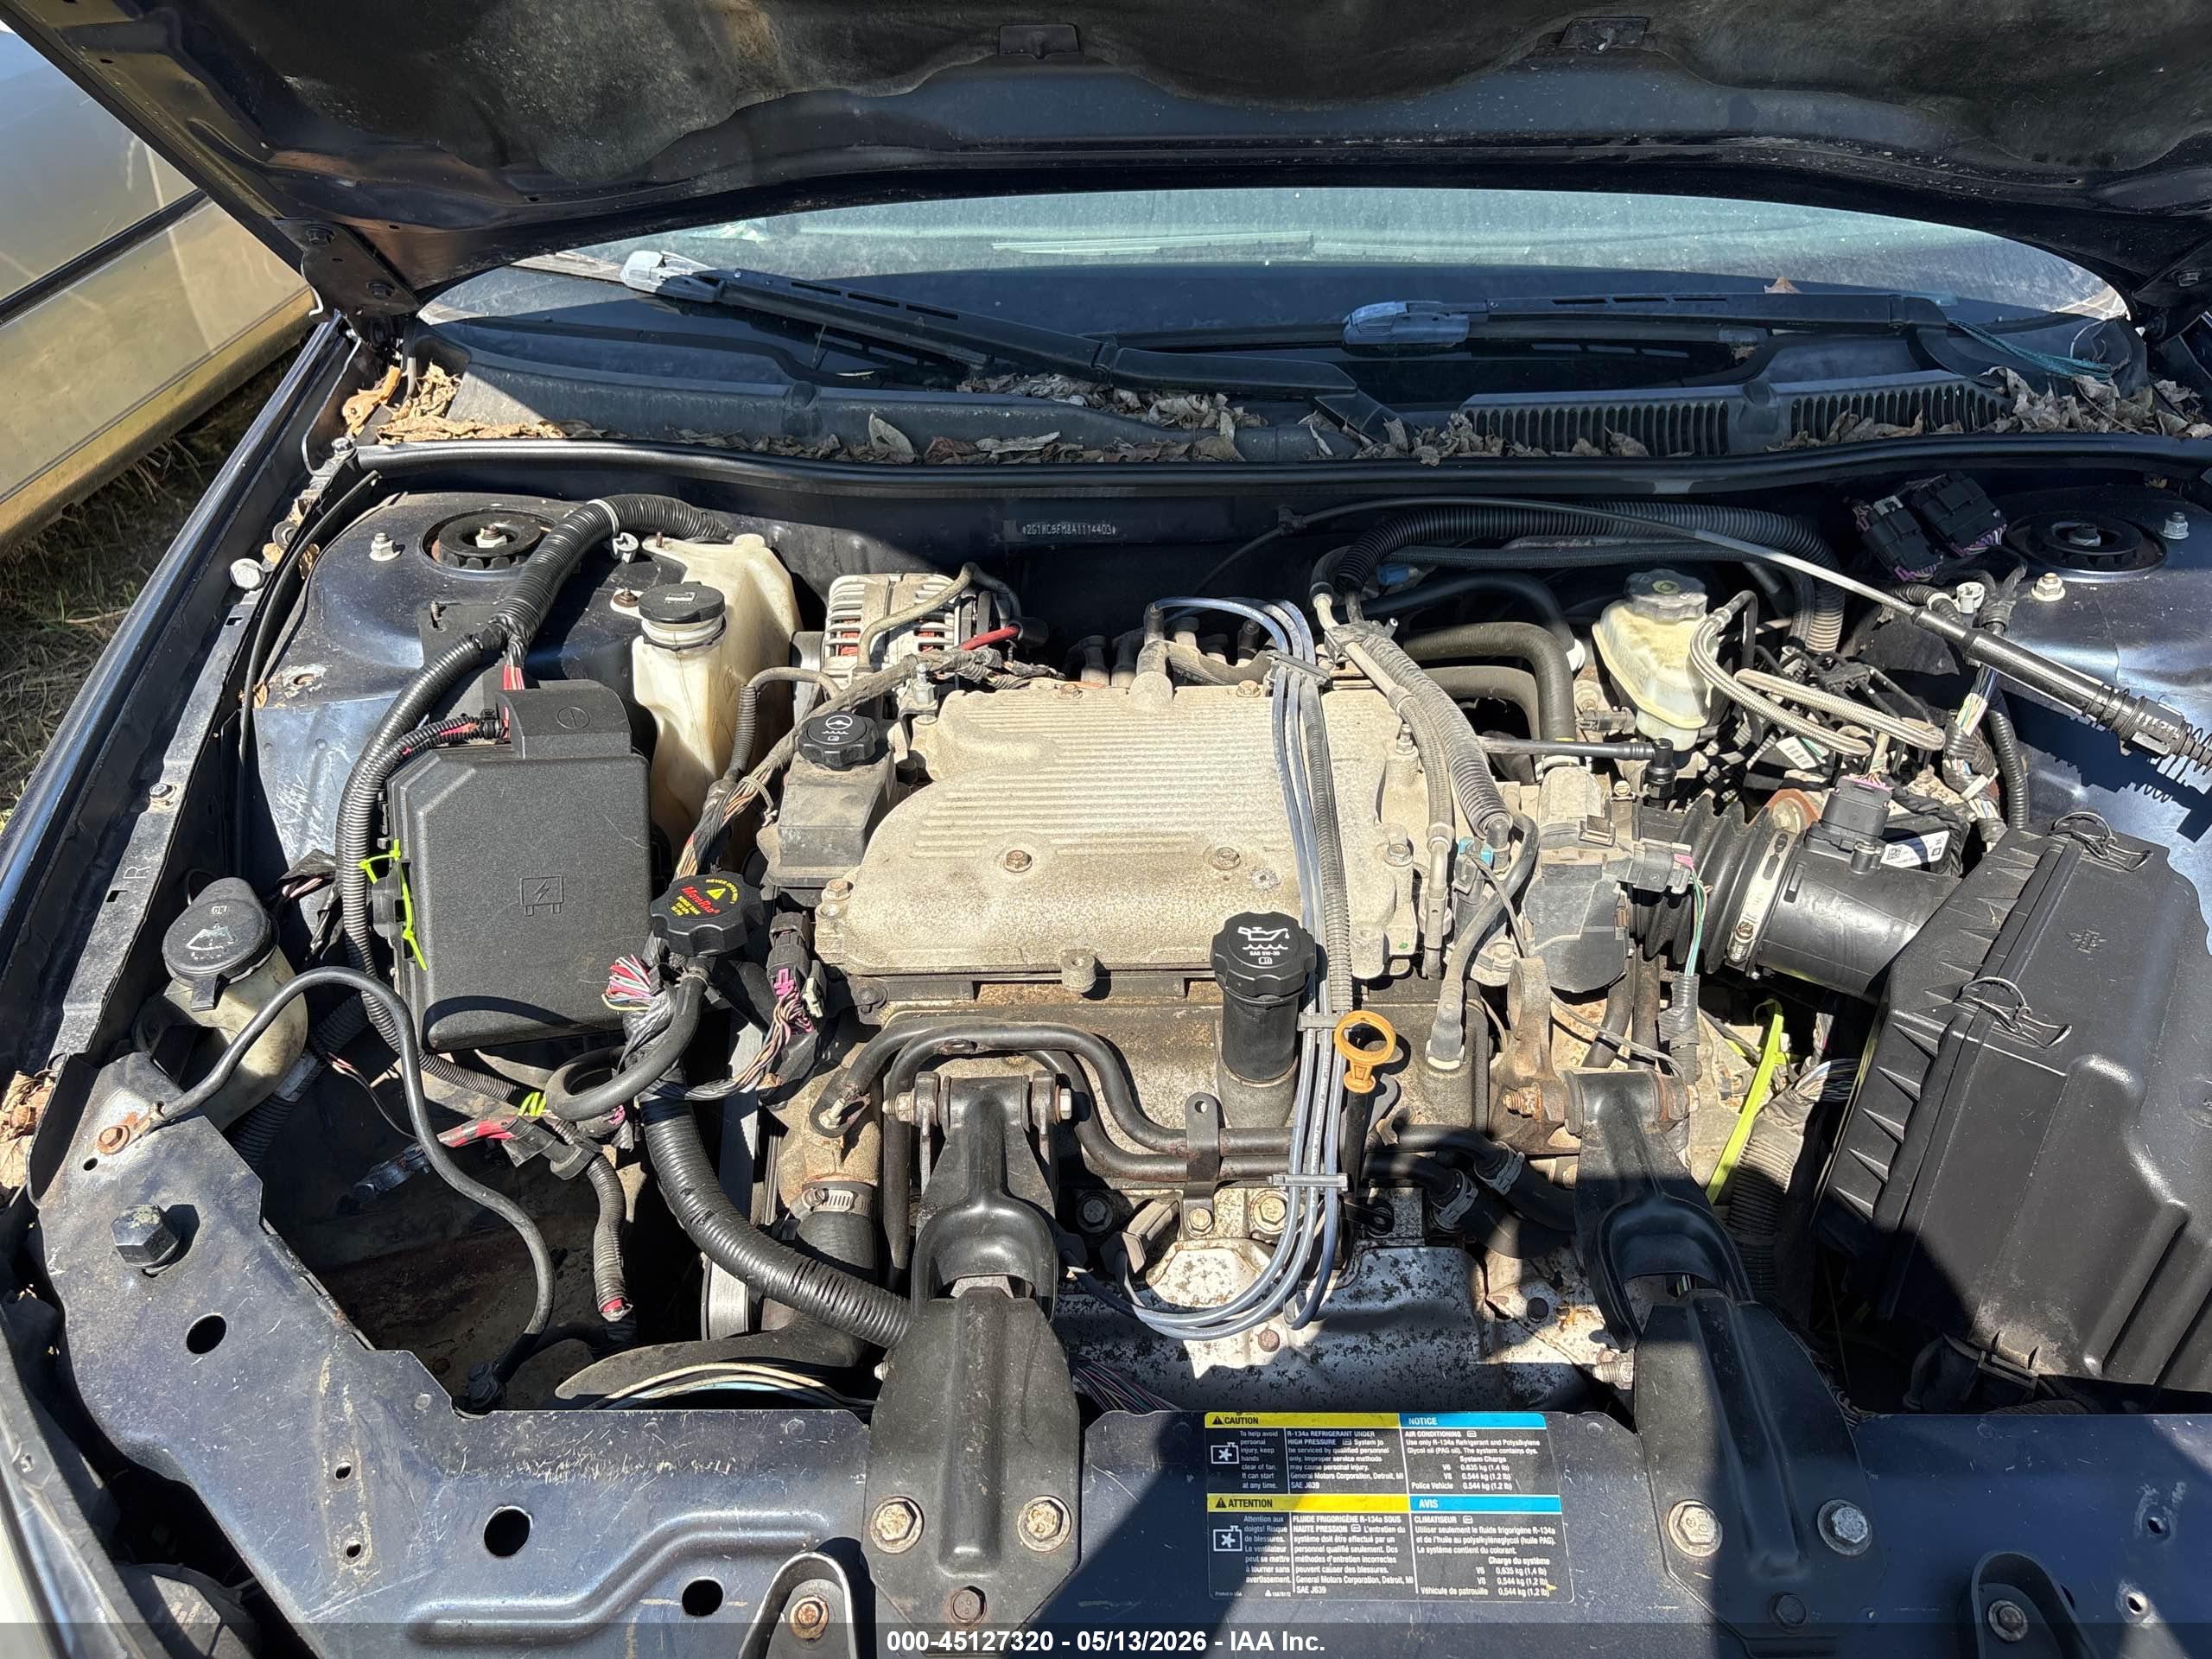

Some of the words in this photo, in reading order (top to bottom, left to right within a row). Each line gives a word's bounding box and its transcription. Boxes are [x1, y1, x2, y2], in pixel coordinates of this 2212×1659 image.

[1482, 1483, 1490, 1491] kg
[1228, 1499, 1272, 1507] ATTENTION
[1419, 1499, 1438, 1509] AVIS
[1294, 1545, 1325, 1554] personnel
[1488, 1557, 1511, 1565] Charge
[1515, 1567, 1524, 1576] kg
[1343, 1576, 1381, 1585] Corporation,
[1516, 1578, 1525, 1587] kg
[1458, 1587, 1488, 1596] patrouille
[1518, 1588, 1526, 1597] kg
